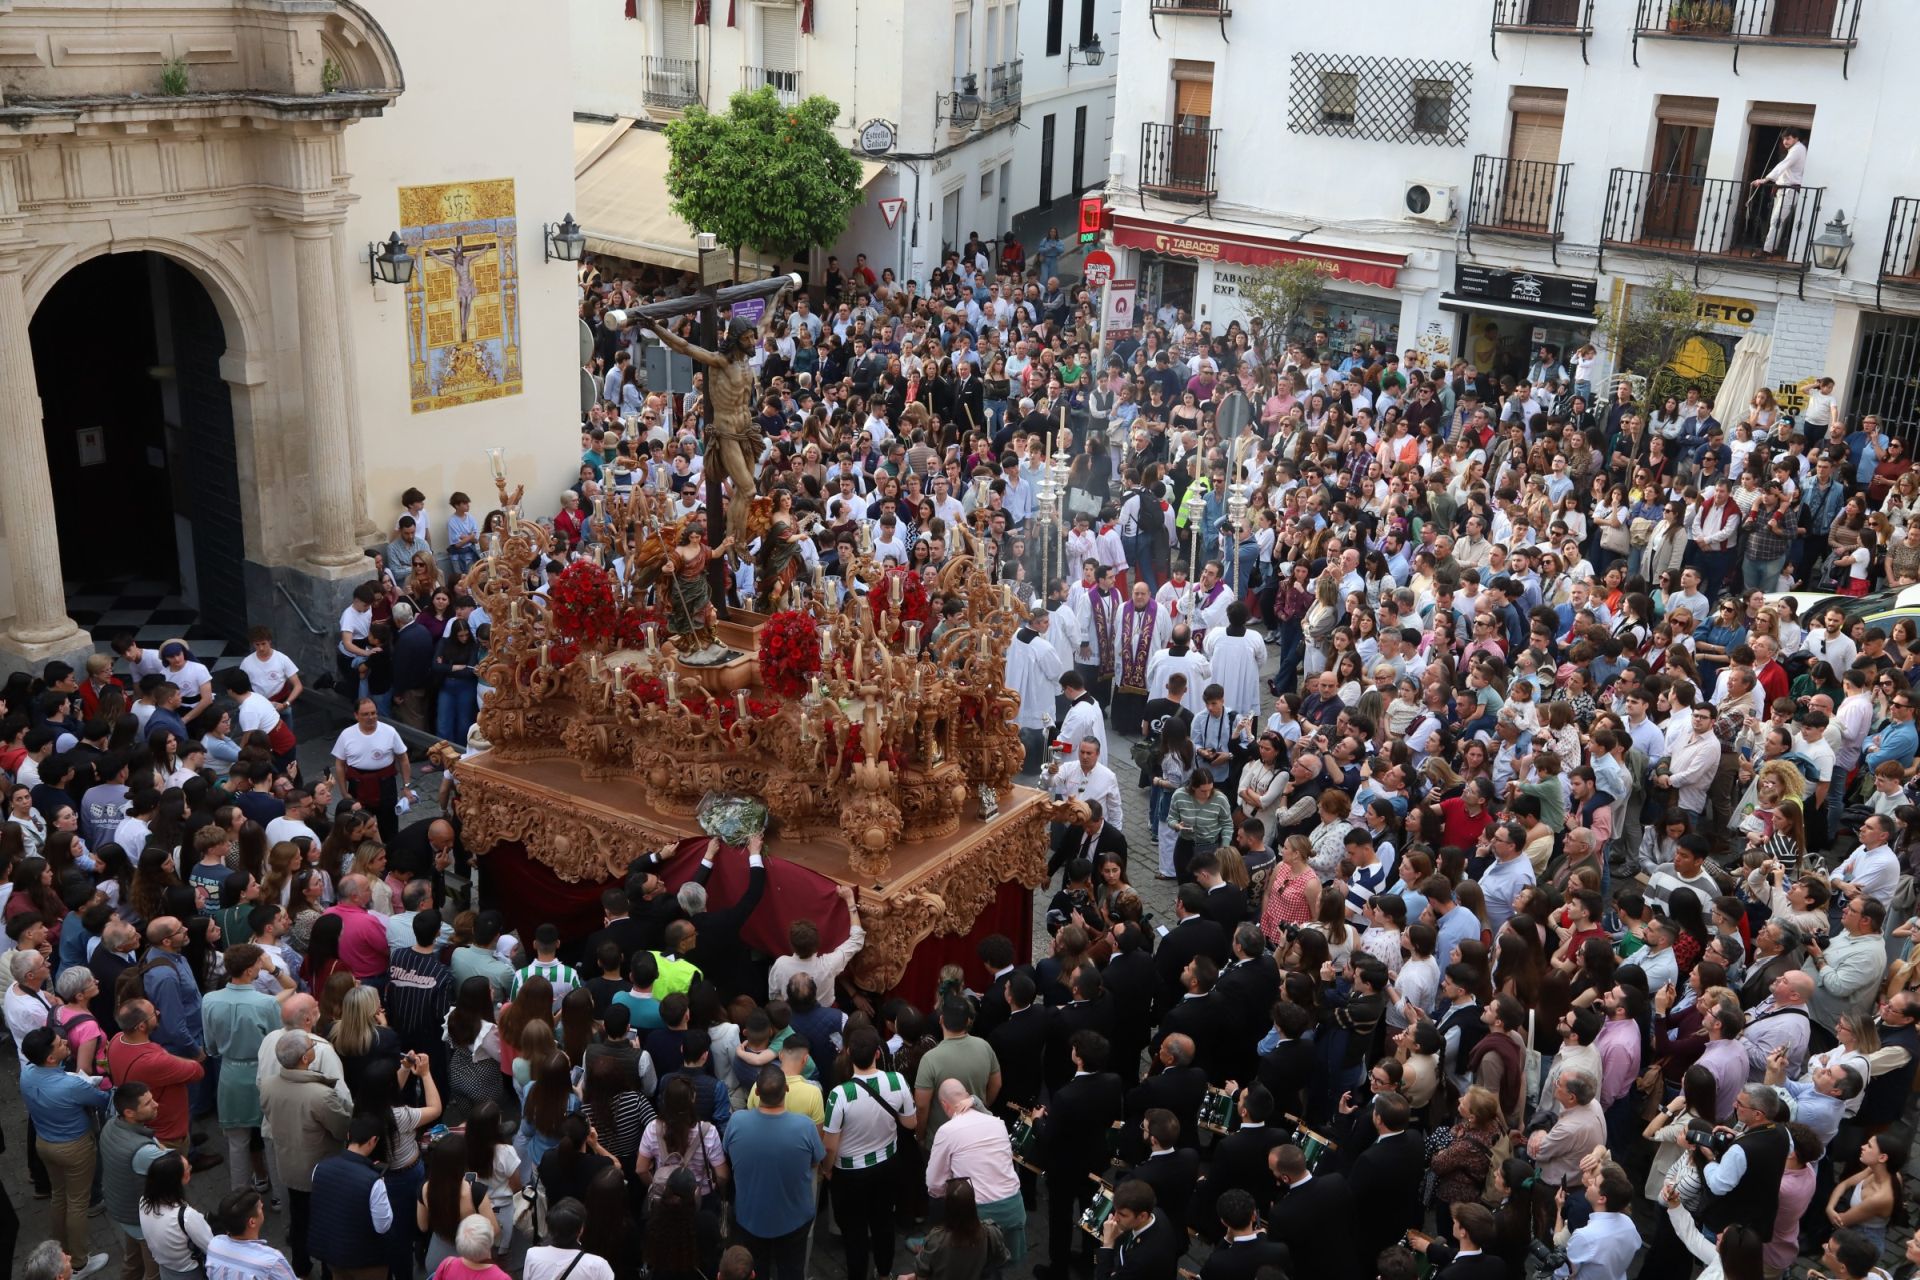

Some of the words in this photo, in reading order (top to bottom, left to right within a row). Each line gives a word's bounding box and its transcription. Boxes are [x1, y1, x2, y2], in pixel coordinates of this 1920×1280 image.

[865, 130, 889, 140] Estrella
[866, 139, 888, 149] Galicia
[1173, 238, 1220, 254] TABACOS
[1297, 257, 1340, 273] PNSA
[1213, 285, 1235, 295] EXP
